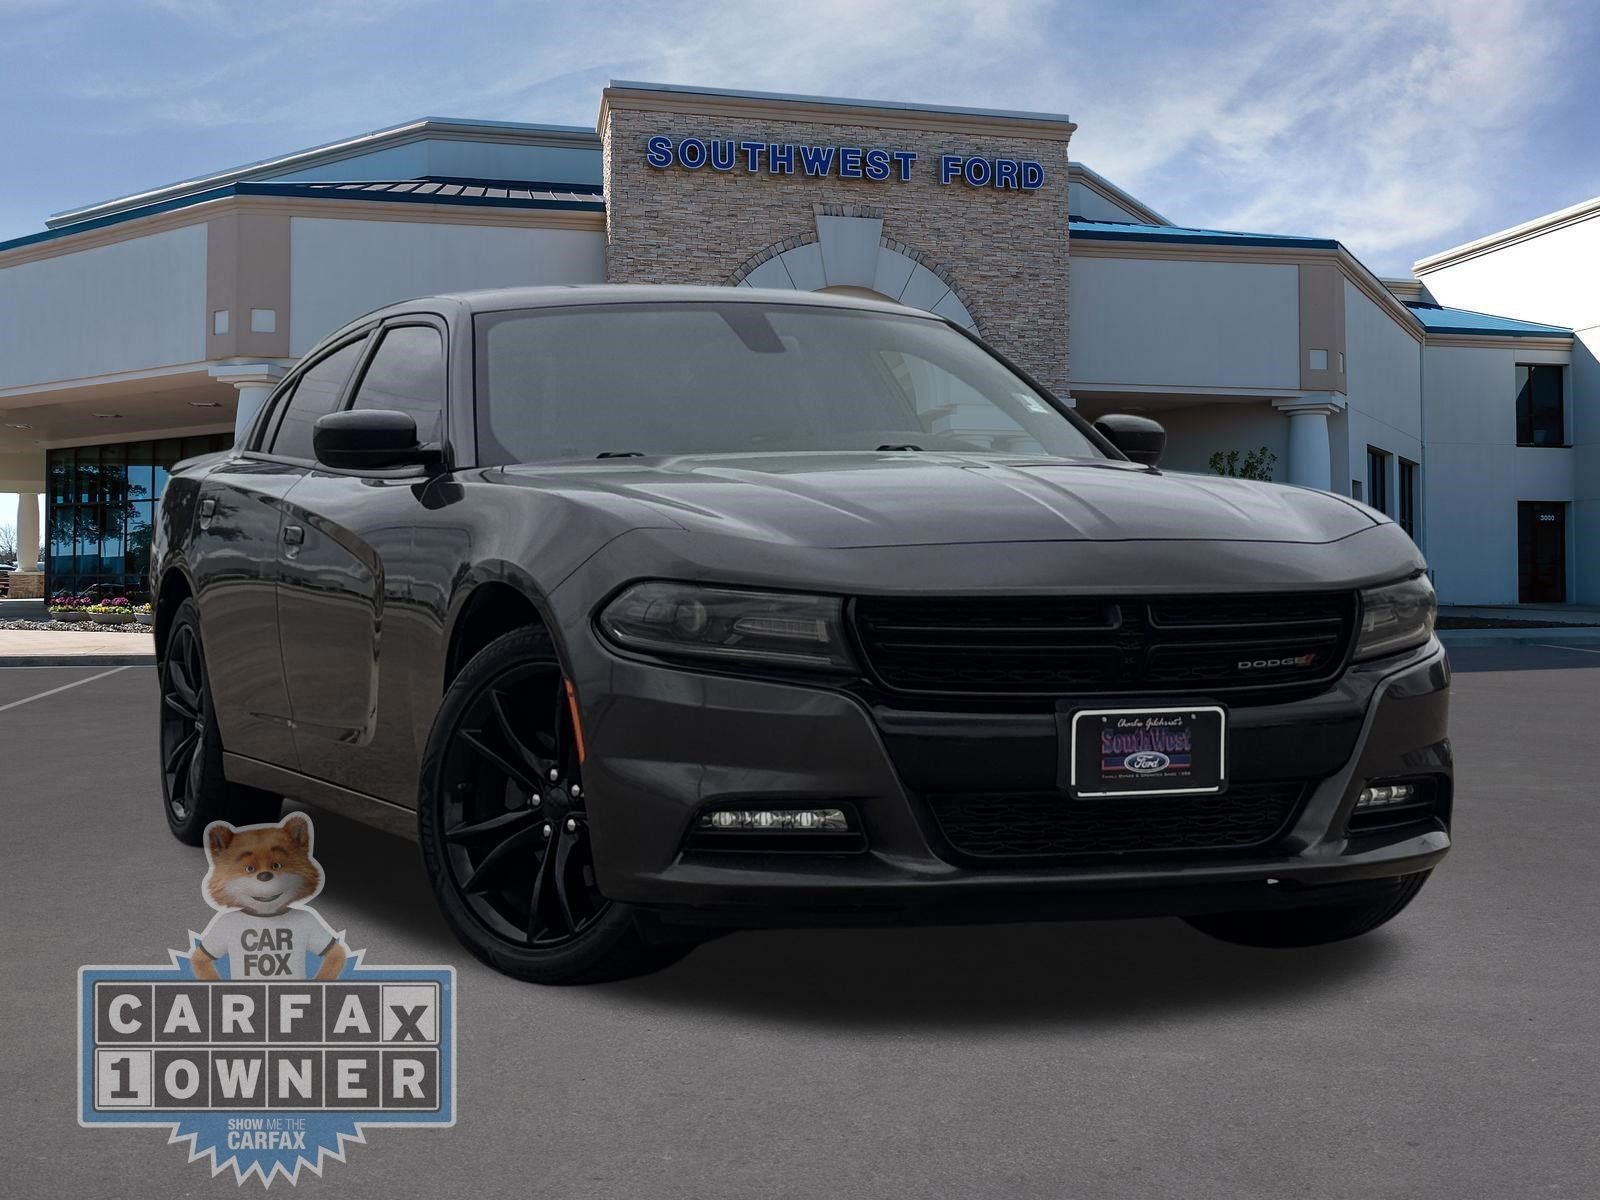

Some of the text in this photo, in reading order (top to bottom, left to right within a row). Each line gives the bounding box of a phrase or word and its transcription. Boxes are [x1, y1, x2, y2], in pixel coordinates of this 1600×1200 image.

[647, 136, 1045, 190] SOUTHWEST FORD
[1237, 656, 1305, 669] DODGE
[1134, 755, 1160, 768] Ford
